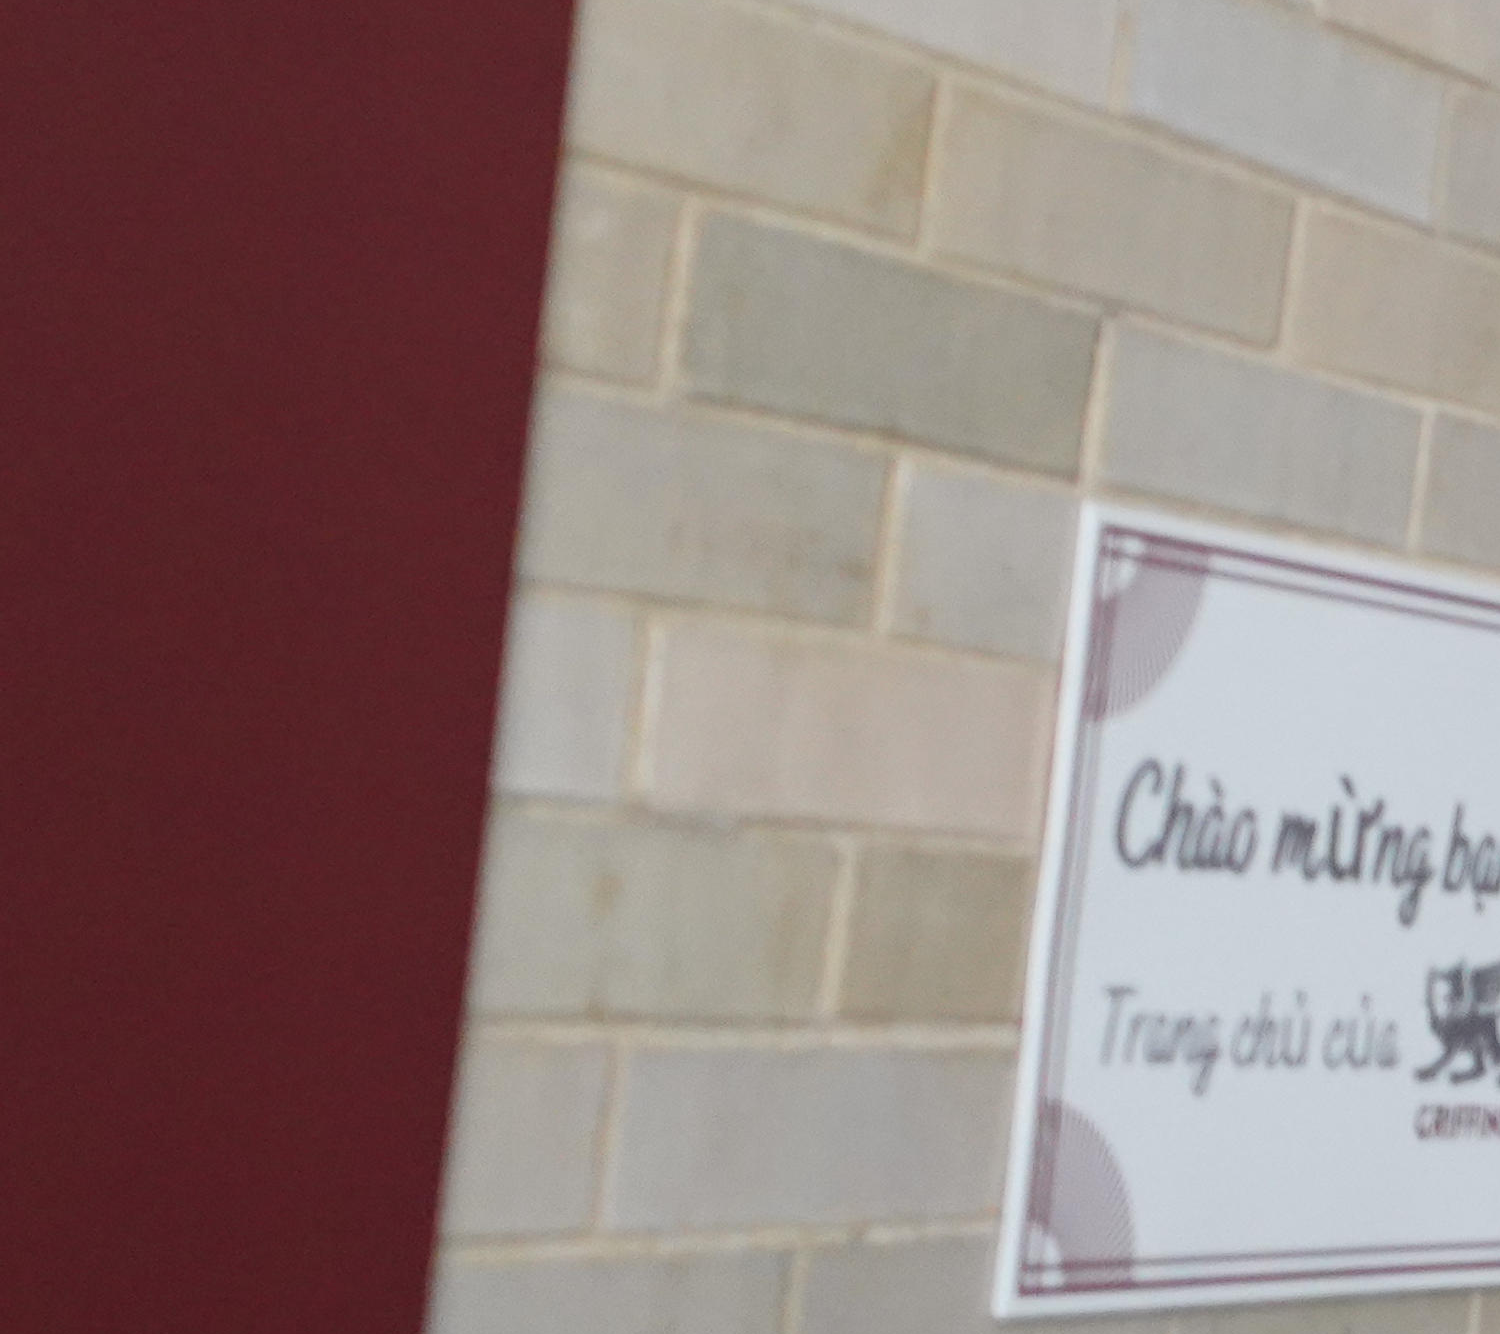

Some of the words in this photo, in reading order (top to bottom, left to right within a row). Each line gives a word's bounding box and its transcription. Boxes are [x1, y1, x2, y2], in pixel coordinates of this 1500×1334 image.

[1112, 757, 1257, 875] Chào
[1270, 773, 1434, 929] mừng
[1101, 983, 1223, 1098] Trang
[1229, 989, 1312, 1070] chủ
[1321, 992, 1399, 1071] của
